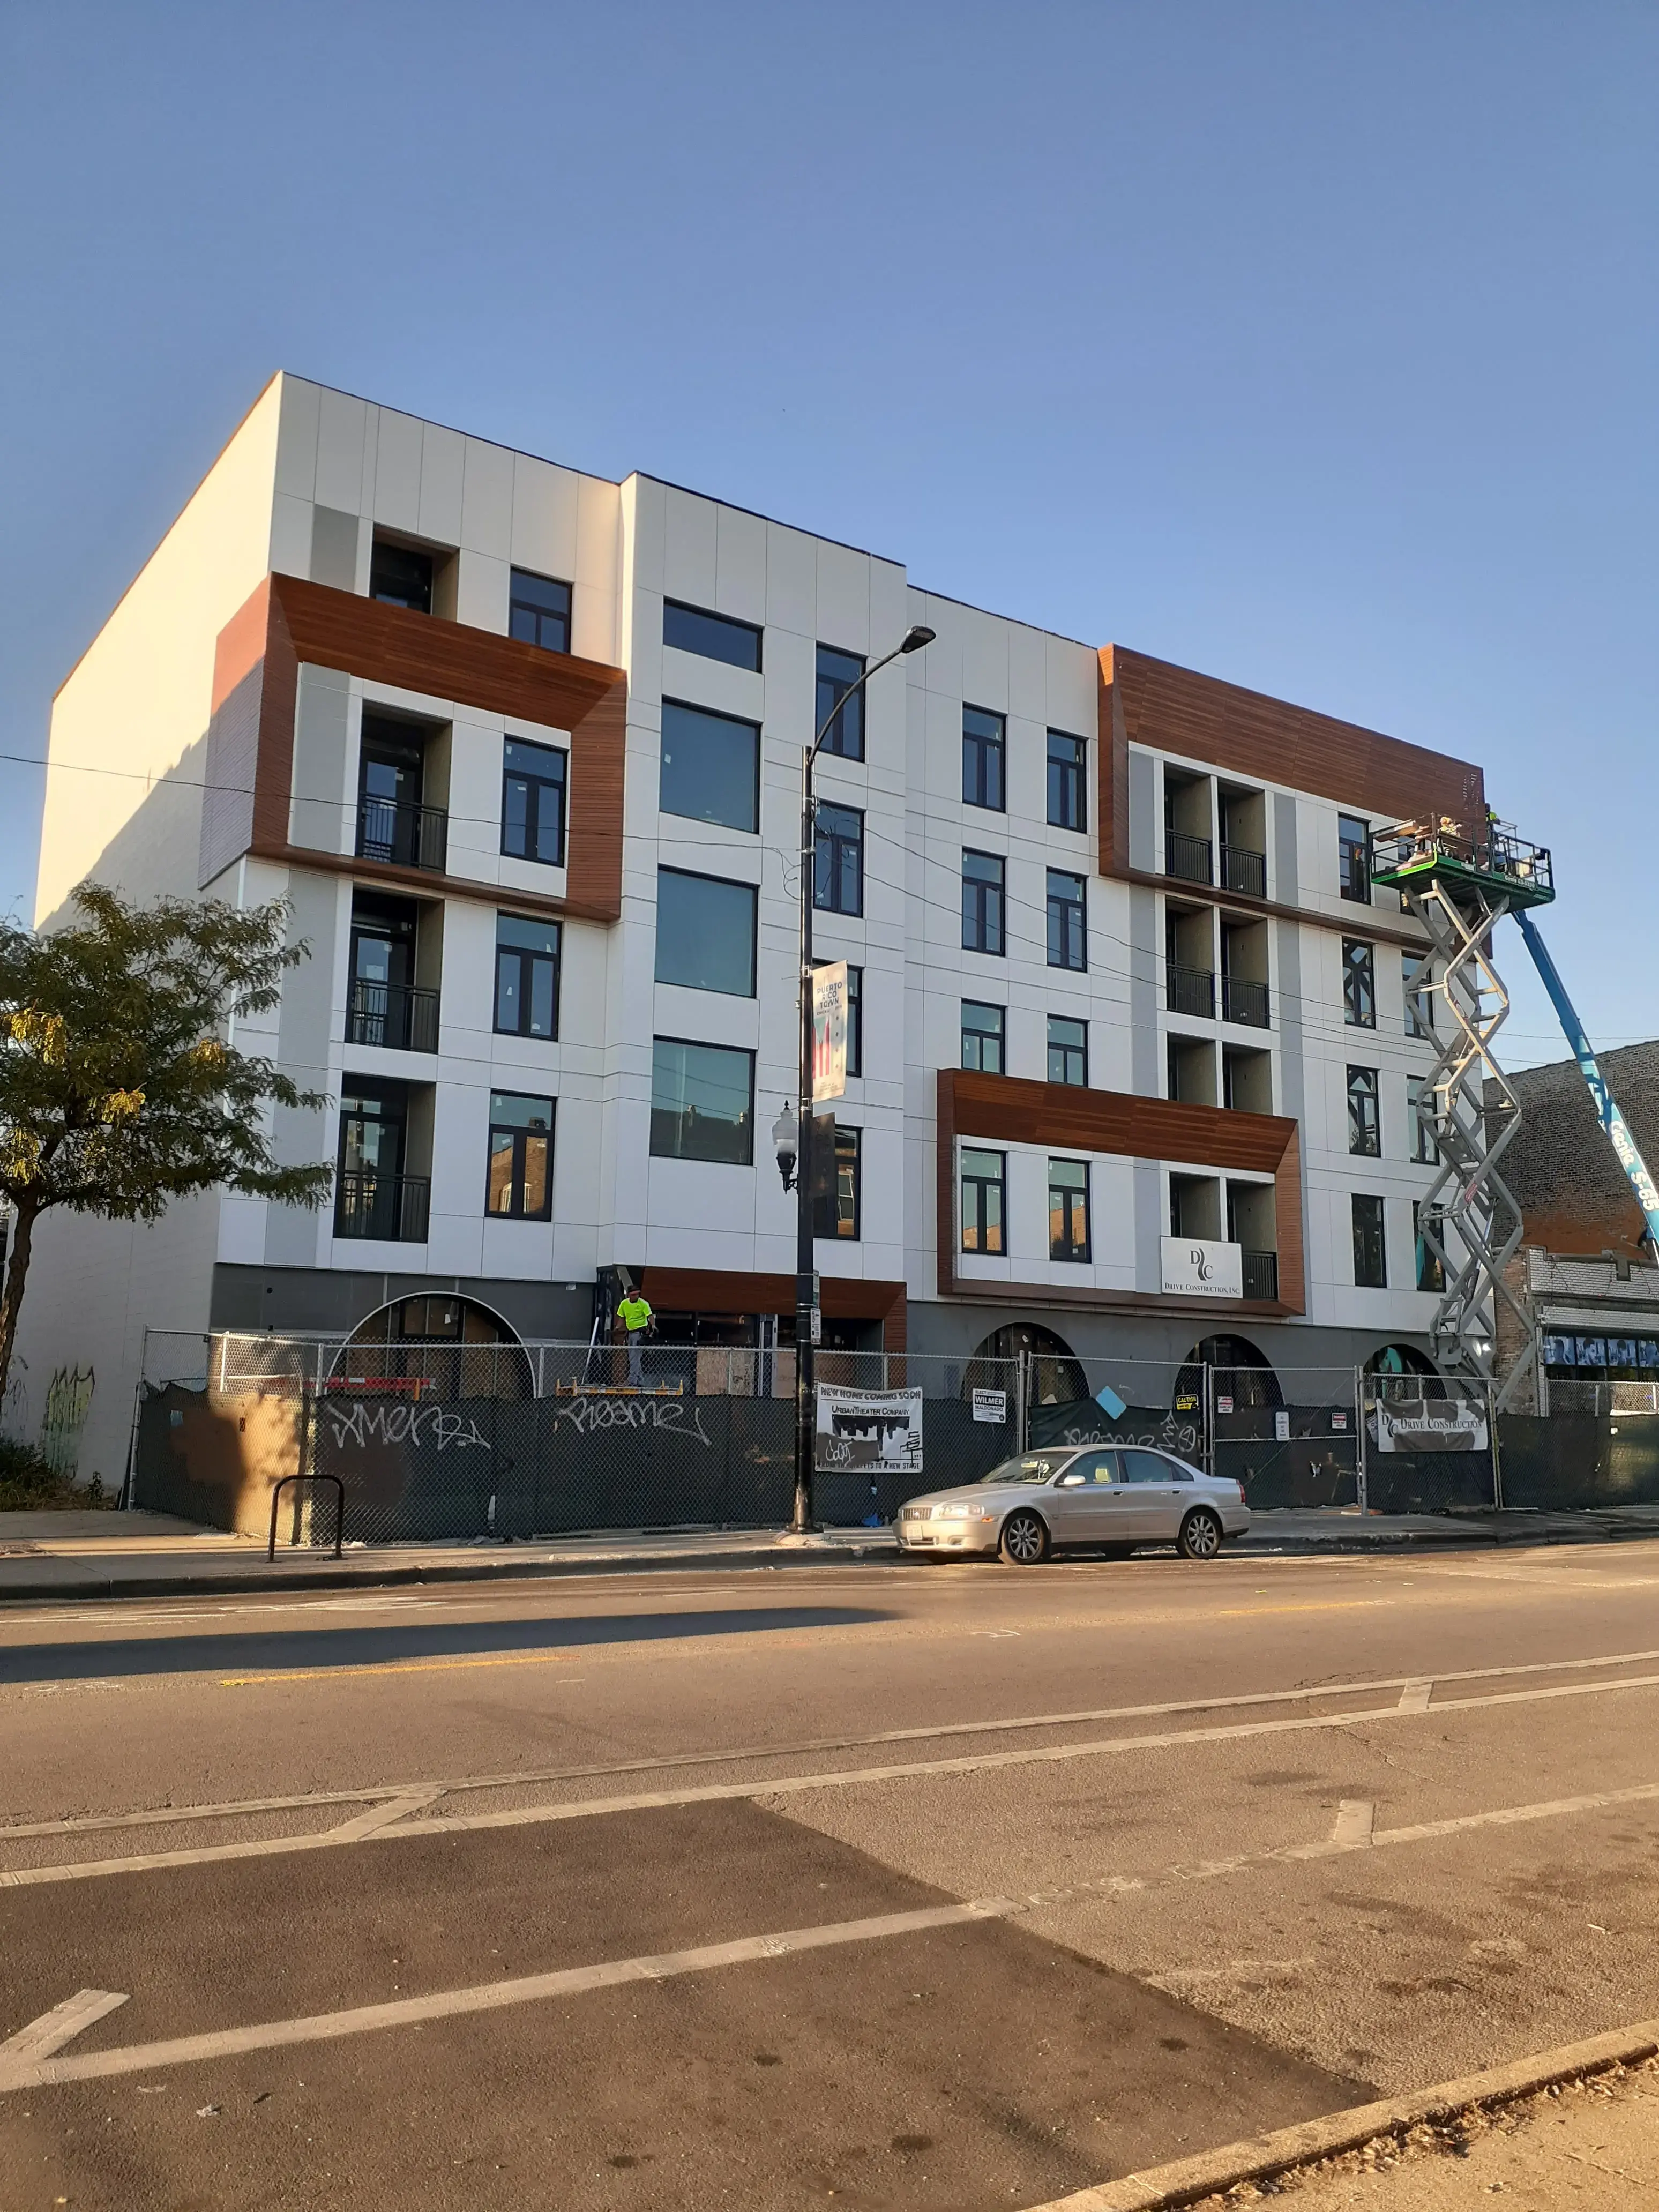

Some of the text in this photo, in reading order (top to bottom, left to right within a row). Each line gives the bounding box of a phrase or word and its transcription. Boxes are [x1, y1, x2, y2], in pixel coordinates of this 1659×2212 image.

[817, 981, 842, 995] PUERTO
[822, 991, 837, 1002] RICO
[820, 997, 839, 1009] TOWN
[1611, 1120, 1659, 1211] Genie S-65
[1165, 1282, 1184, 1290] DRIVE
[821, 1387, 839, 1396] NEW
[840, 1389, 863, 1400] HOME
[899, 1391, 921, 1400] SOON
[975, 1396, 1003, 1406] WILMER
[882, 1407, 909, 1415] COMPANY
[1401, 1418, 1482, 1429] DRIVE CONSTRUCTION
